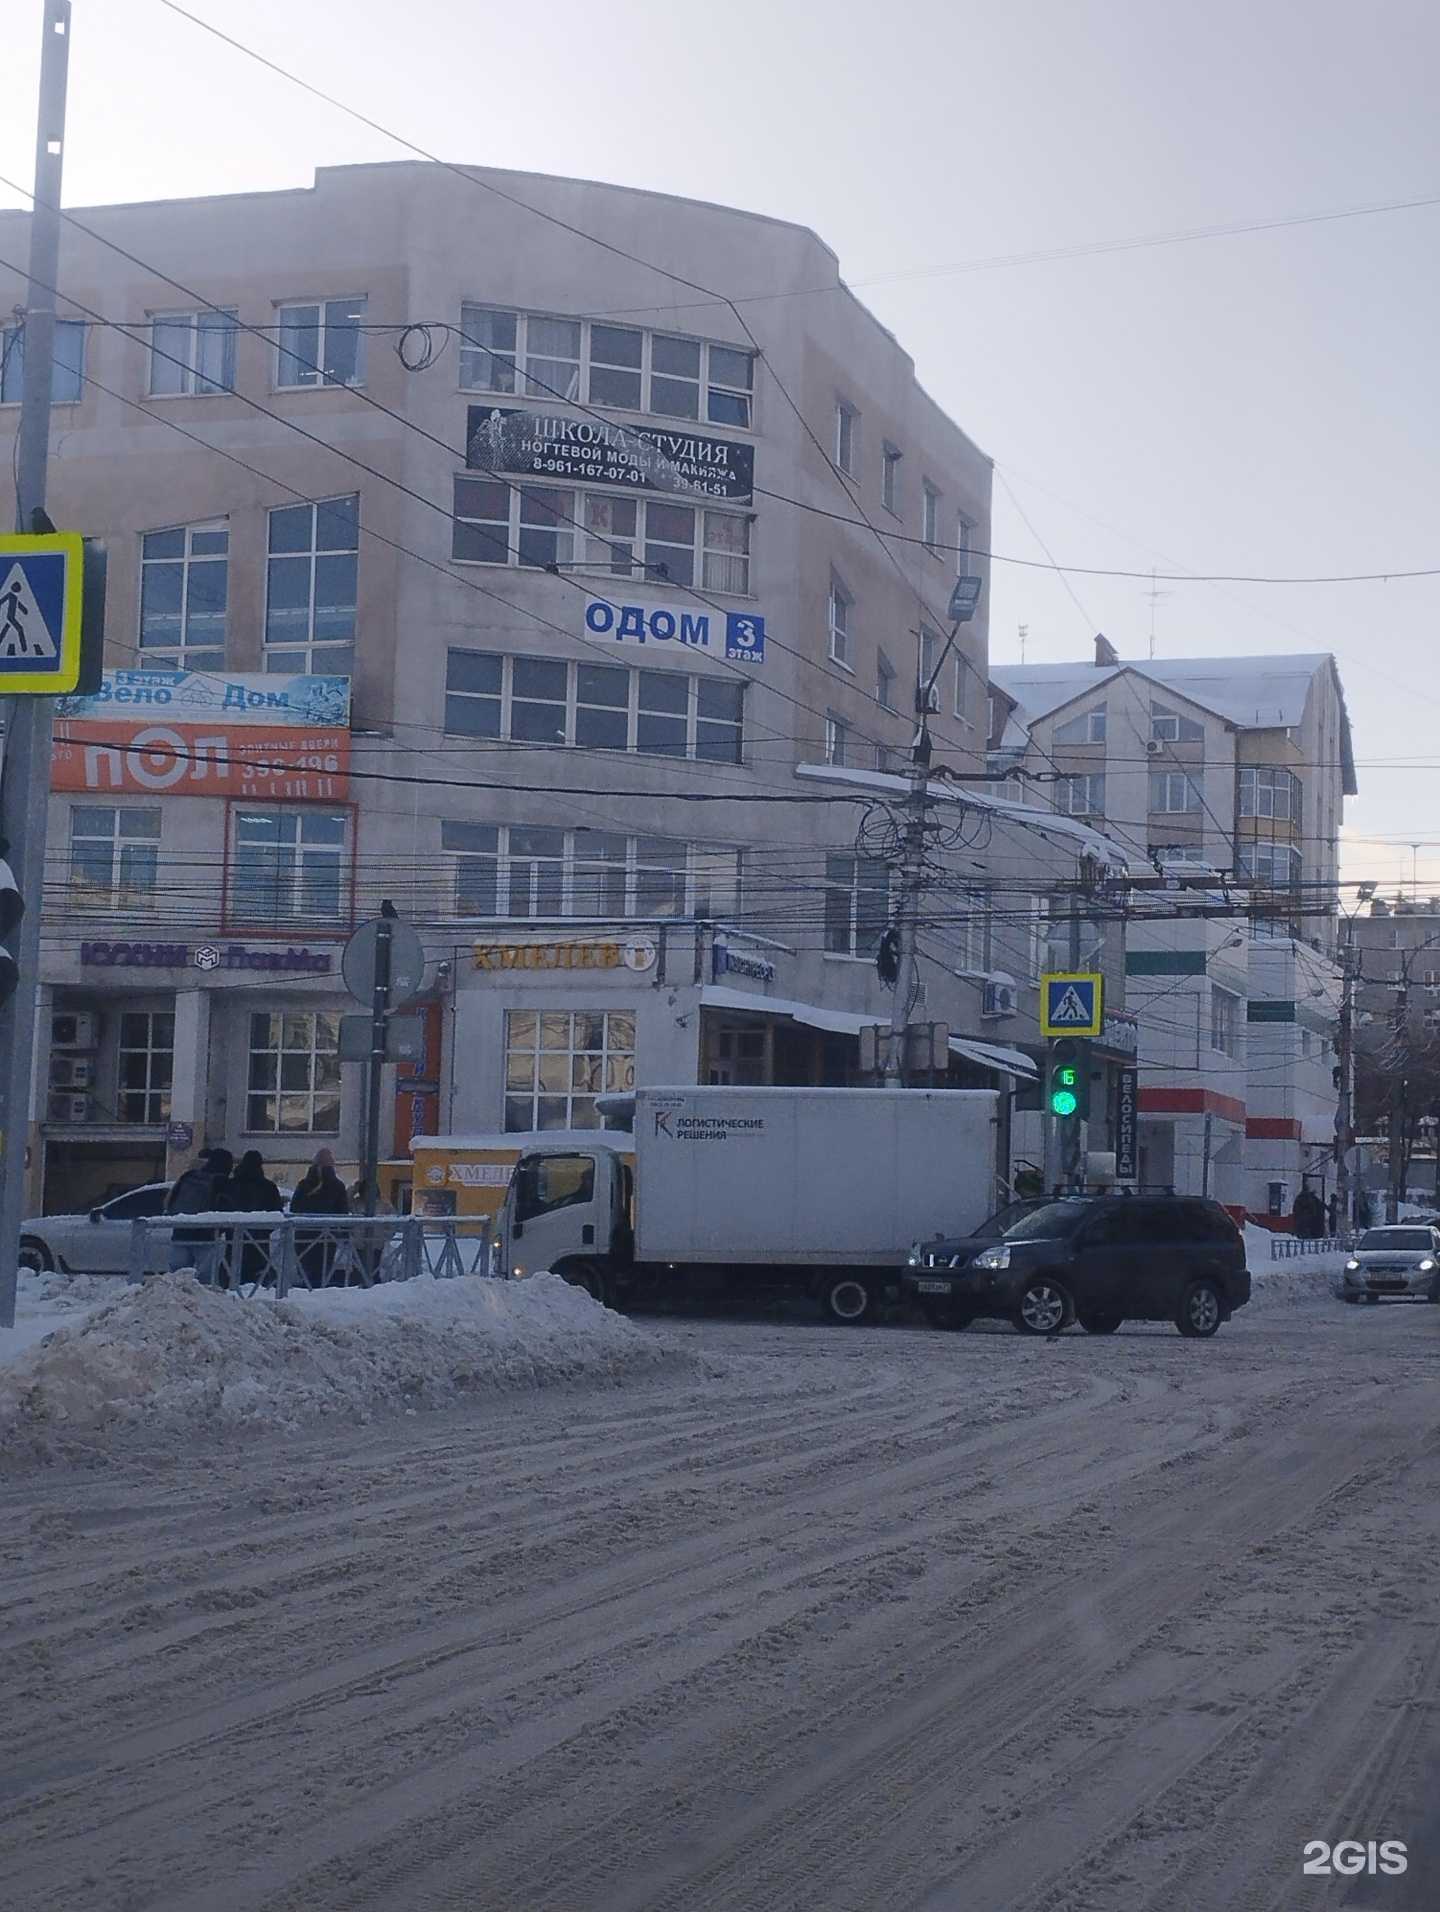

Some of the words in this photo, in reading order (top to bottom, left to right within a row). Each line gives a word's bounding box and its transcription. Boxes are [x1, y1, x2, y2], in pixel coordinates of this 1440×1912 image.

[521, 439, 602, 462] НОГТЕВОЙ
[606, 450, 651, 472] МОДЫ
[532, 457, 647, 483] 8-961-167-07-01
[585, 602, 710, 646] ОДОМ
[736, 619, 756, 648] 3
[676, 1117, 765, 1130] ЛОГИСТИЧЕСКИЕ
[676, 1129, 728, 1141] РЕШЕНИЯ
[1120, 1074, 1134, 1175] ВЕЛОСИПЕДЫ
